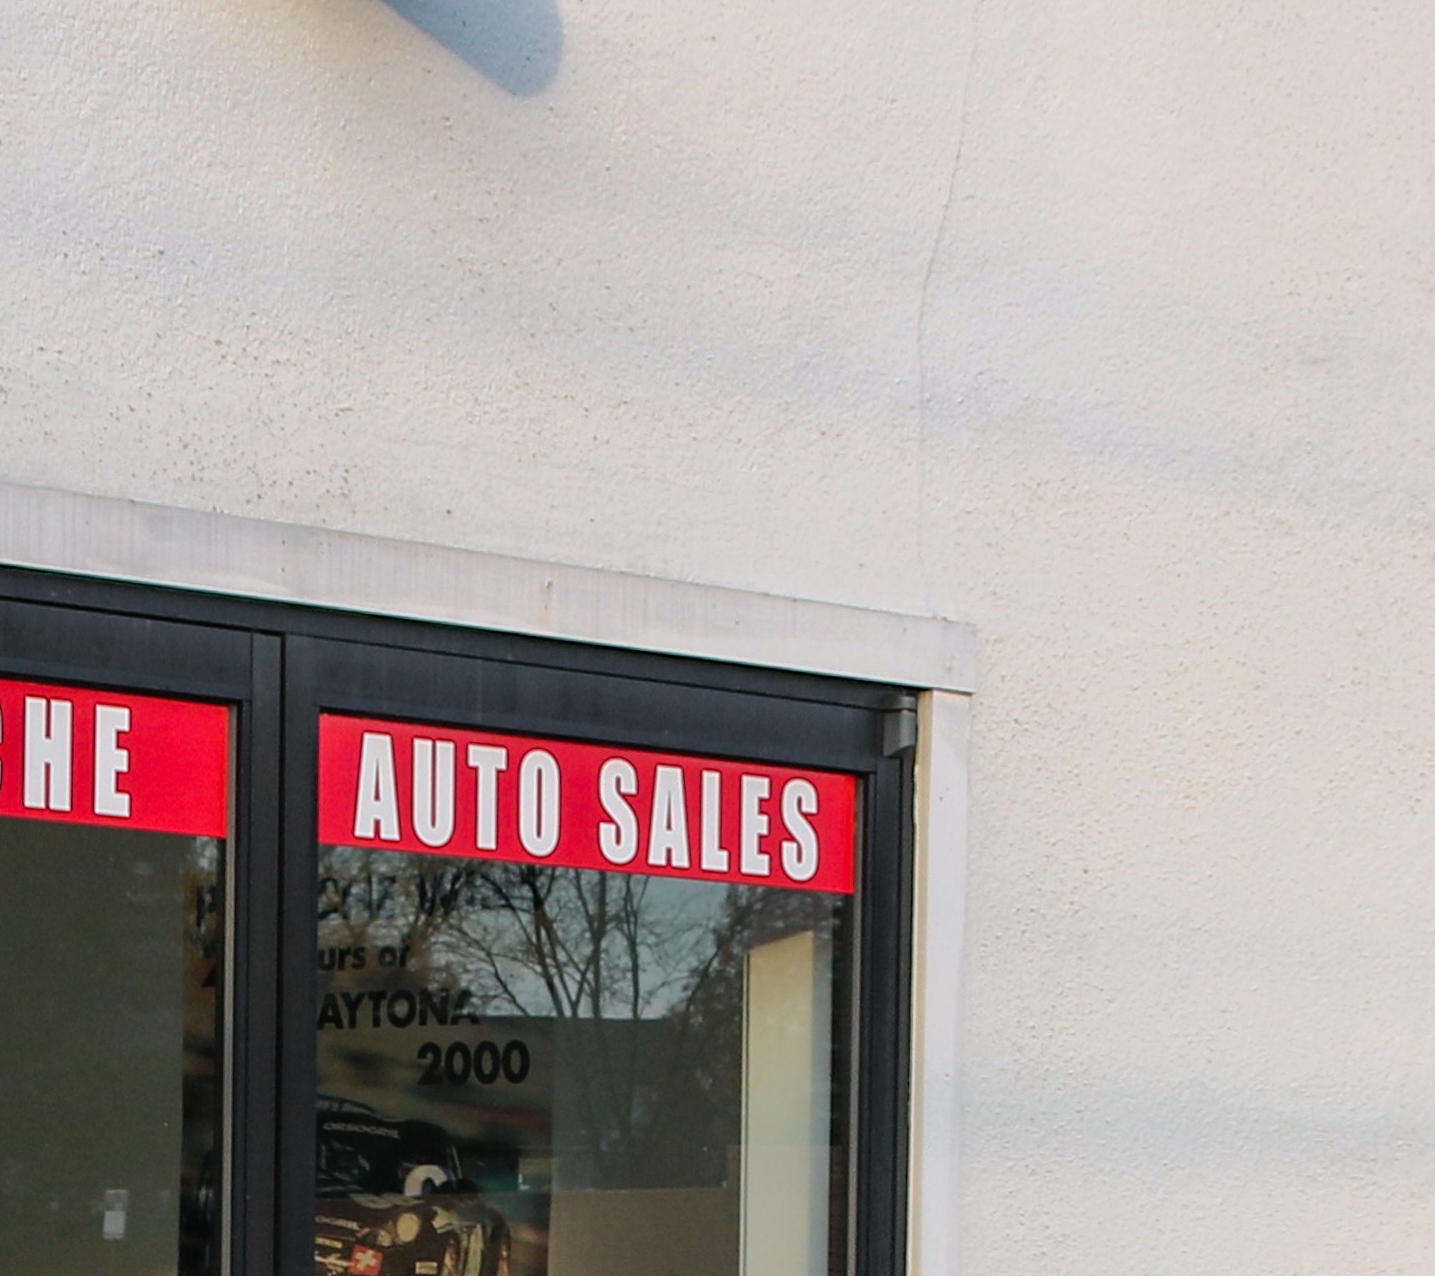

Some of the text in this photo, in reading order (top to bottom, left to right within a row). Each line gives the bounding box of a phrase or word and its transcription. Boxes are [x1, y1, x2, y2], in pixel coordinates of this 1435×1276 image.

[353, 732, 820, 882] AUTO SALES
[417, 1039, 530, 1085] 2000
